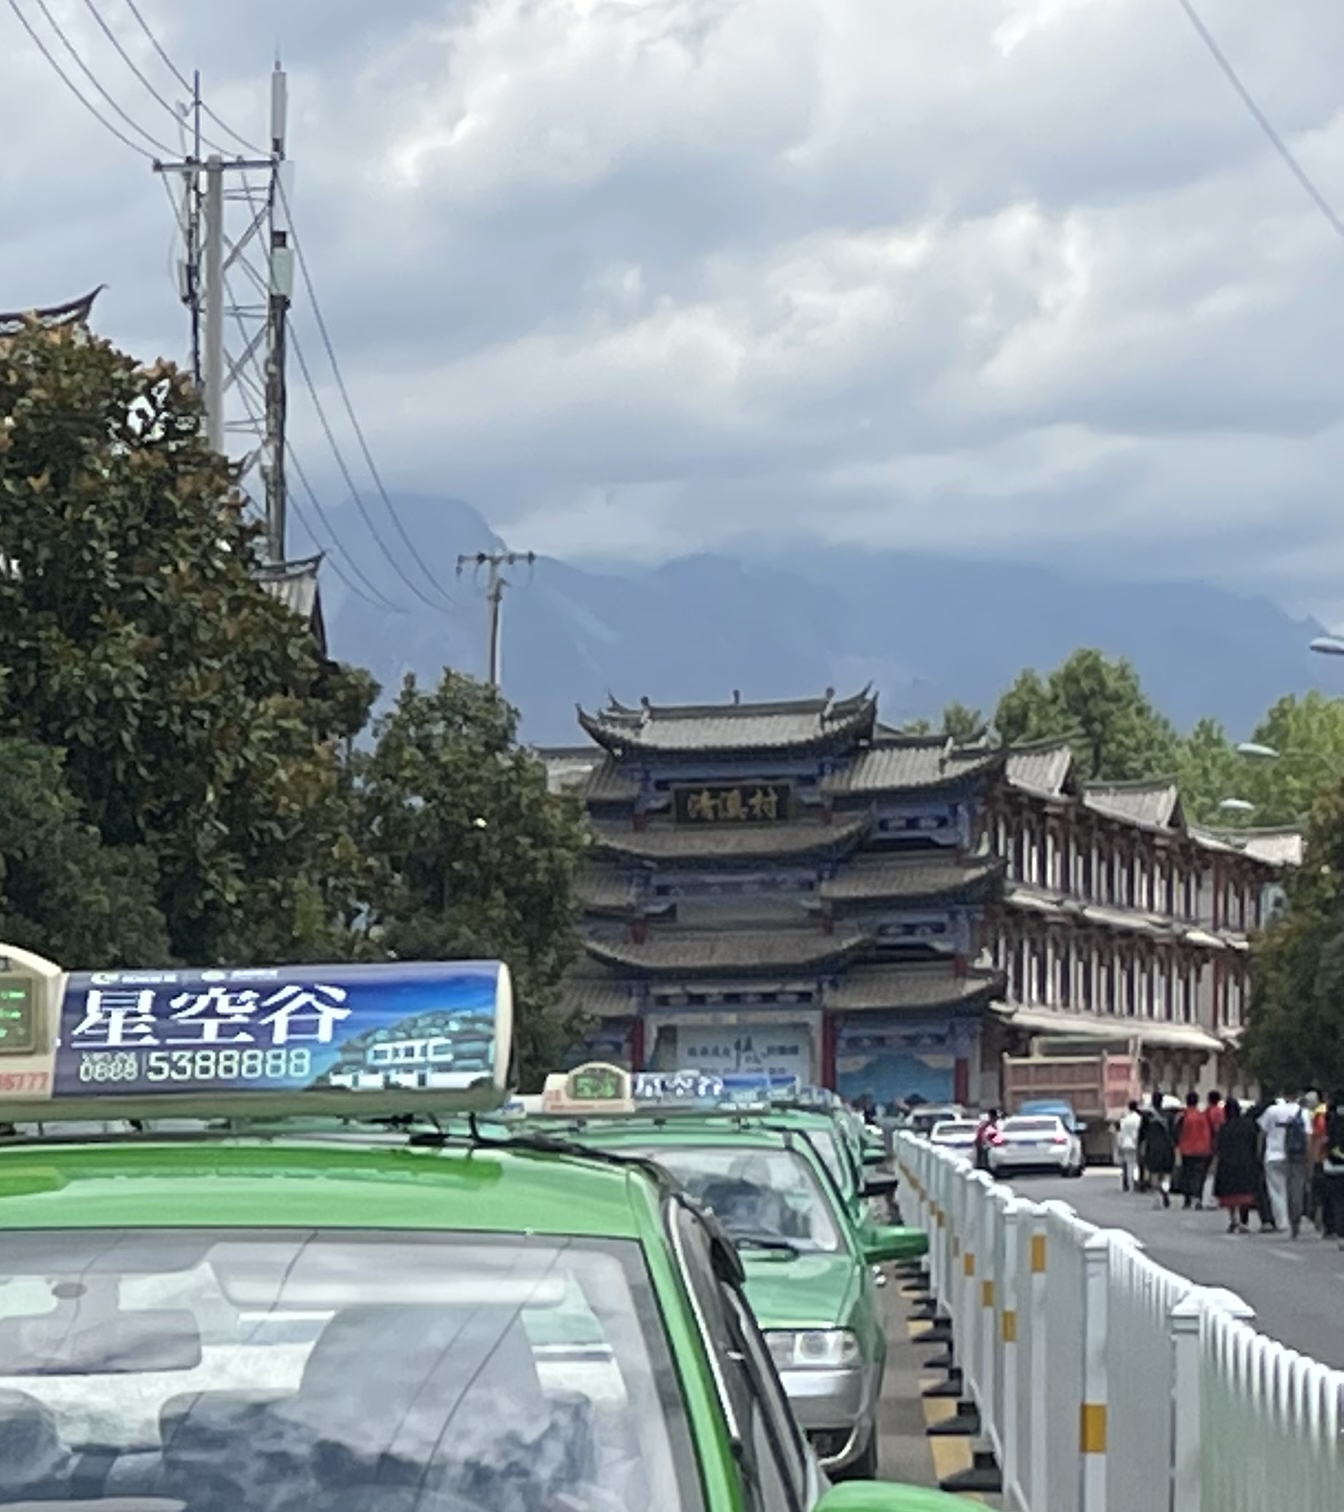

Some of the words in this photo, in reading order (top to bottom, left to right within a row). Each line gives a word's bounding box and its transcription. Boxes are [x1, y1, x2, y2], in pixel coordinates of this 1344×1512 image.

[70, 985, 352, 1049] 星空谷
[146, 1048, 311, 1081] 5388888
